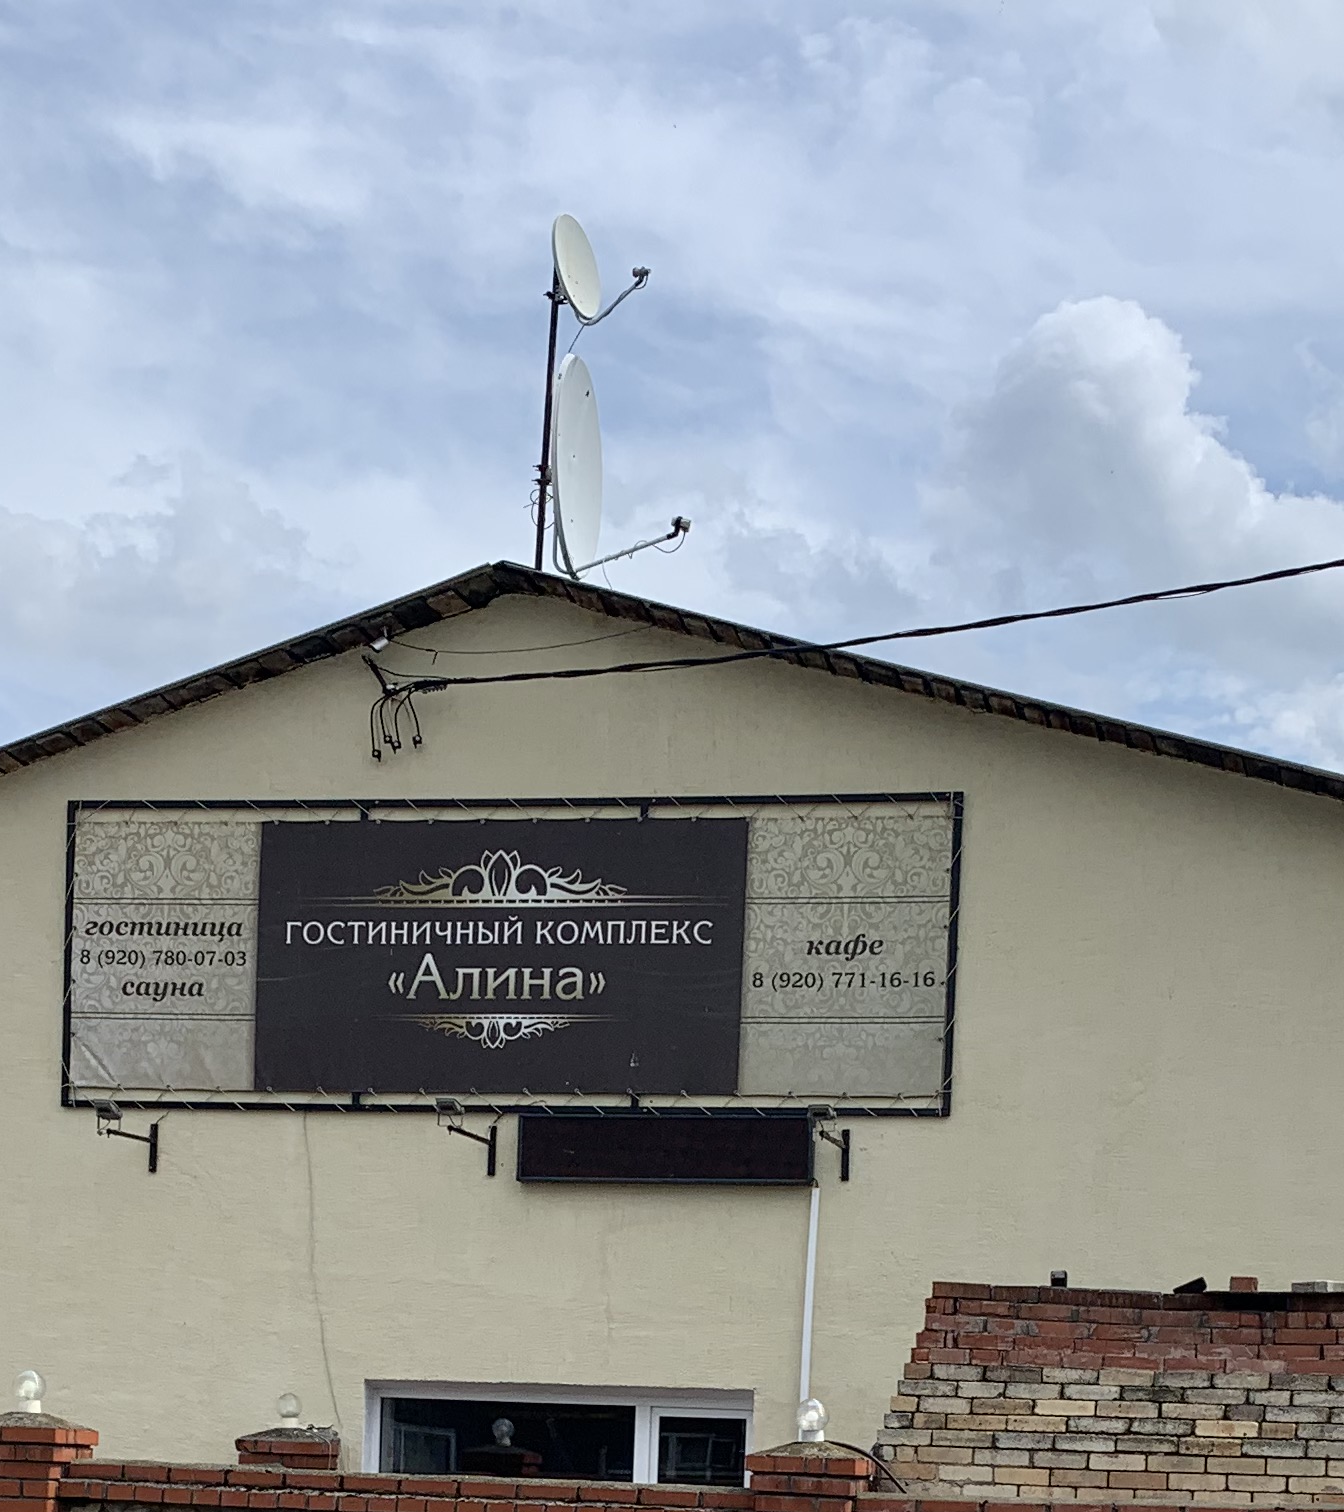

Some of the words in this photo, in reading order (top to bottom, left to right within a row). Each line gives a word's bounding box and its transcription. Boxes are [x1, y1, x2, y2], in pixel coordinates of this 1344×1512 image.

[84, 920, 243, 942] гостиница
[285, 915, 524, 945] ГОСТИНИЧНЫЙ
[535, 919, 714, 945] КОМПЛЕКС
[806, 933, 884, 962] кафе
[79, 950, 91, 965] 8
[97, 949, 146, 969] (920)
[154, 950, 247, 967] 780-07-03
[387, 952, 607, 1001] «Алина»
[752, 971, 764, 988] 8
[771, 971, 824, 992] (920)
[831, 971, 936, 988] 771-16-16
[121, 980, 205, 1002] сауна
